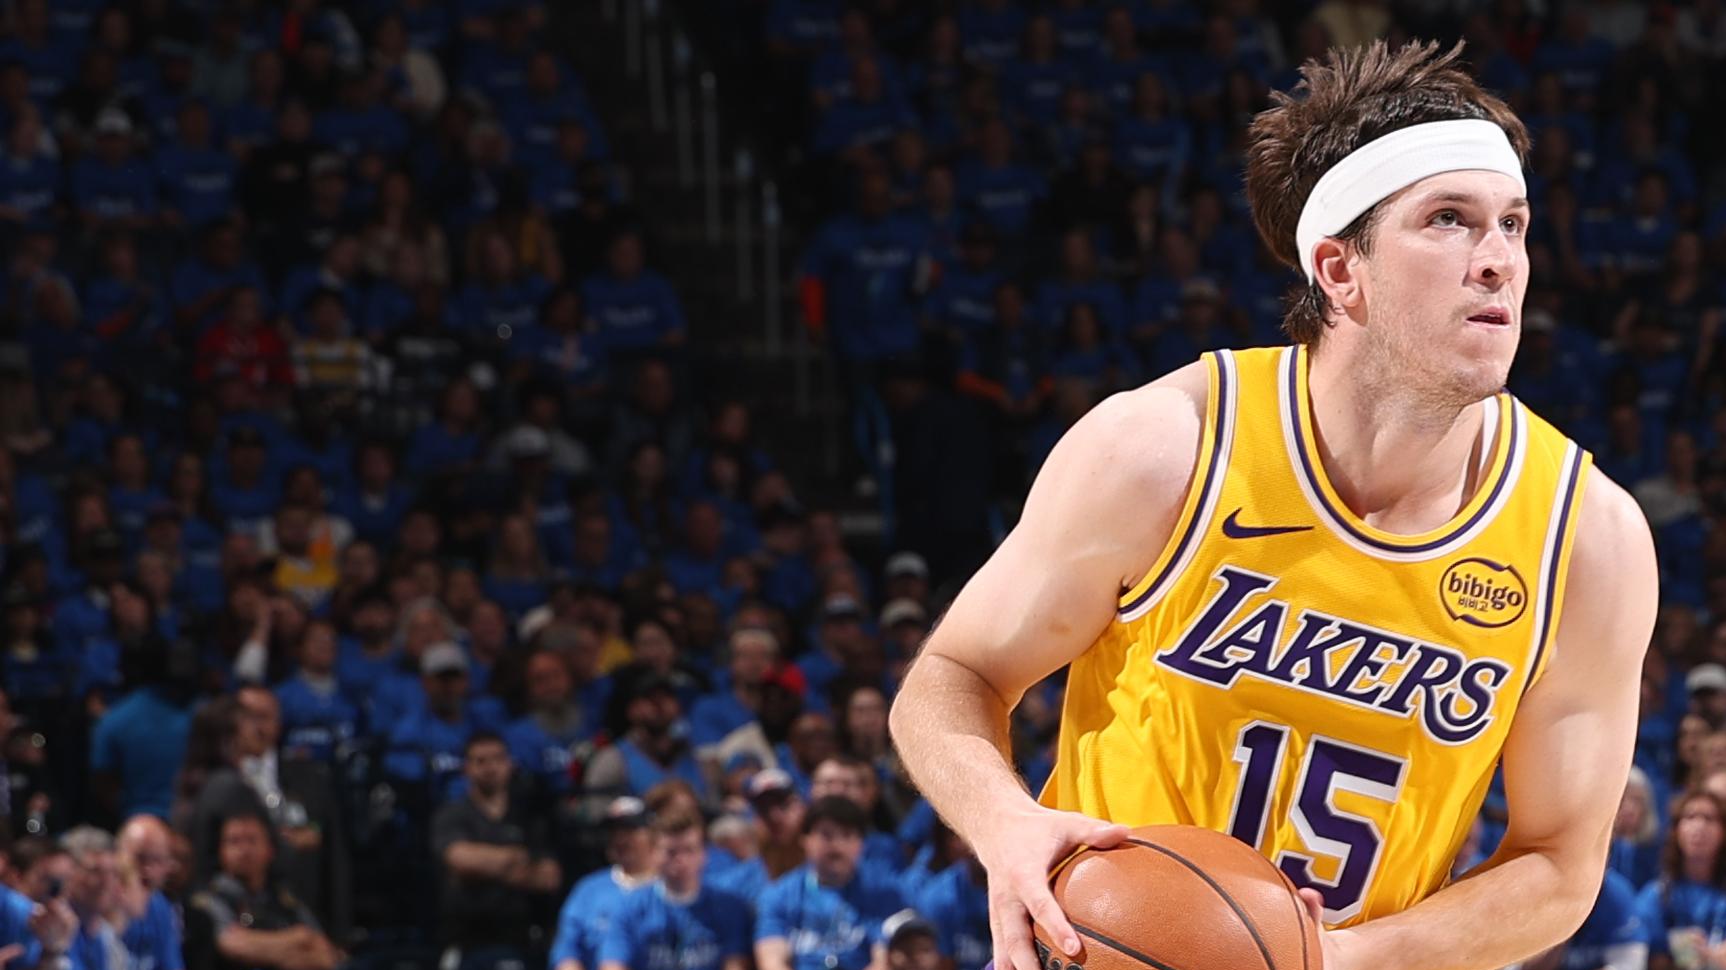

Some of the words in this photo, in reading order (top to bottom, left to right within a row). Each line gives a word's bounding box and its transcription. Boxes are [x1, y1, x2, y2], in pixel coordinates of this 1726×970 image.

[1448, 572, 1522, 610] bibigo
[1458, 596, 1489, 612] 비비고
[1156, 566, 1510, 744] LAKERS
[1231, 720, 1409, 925] 15
